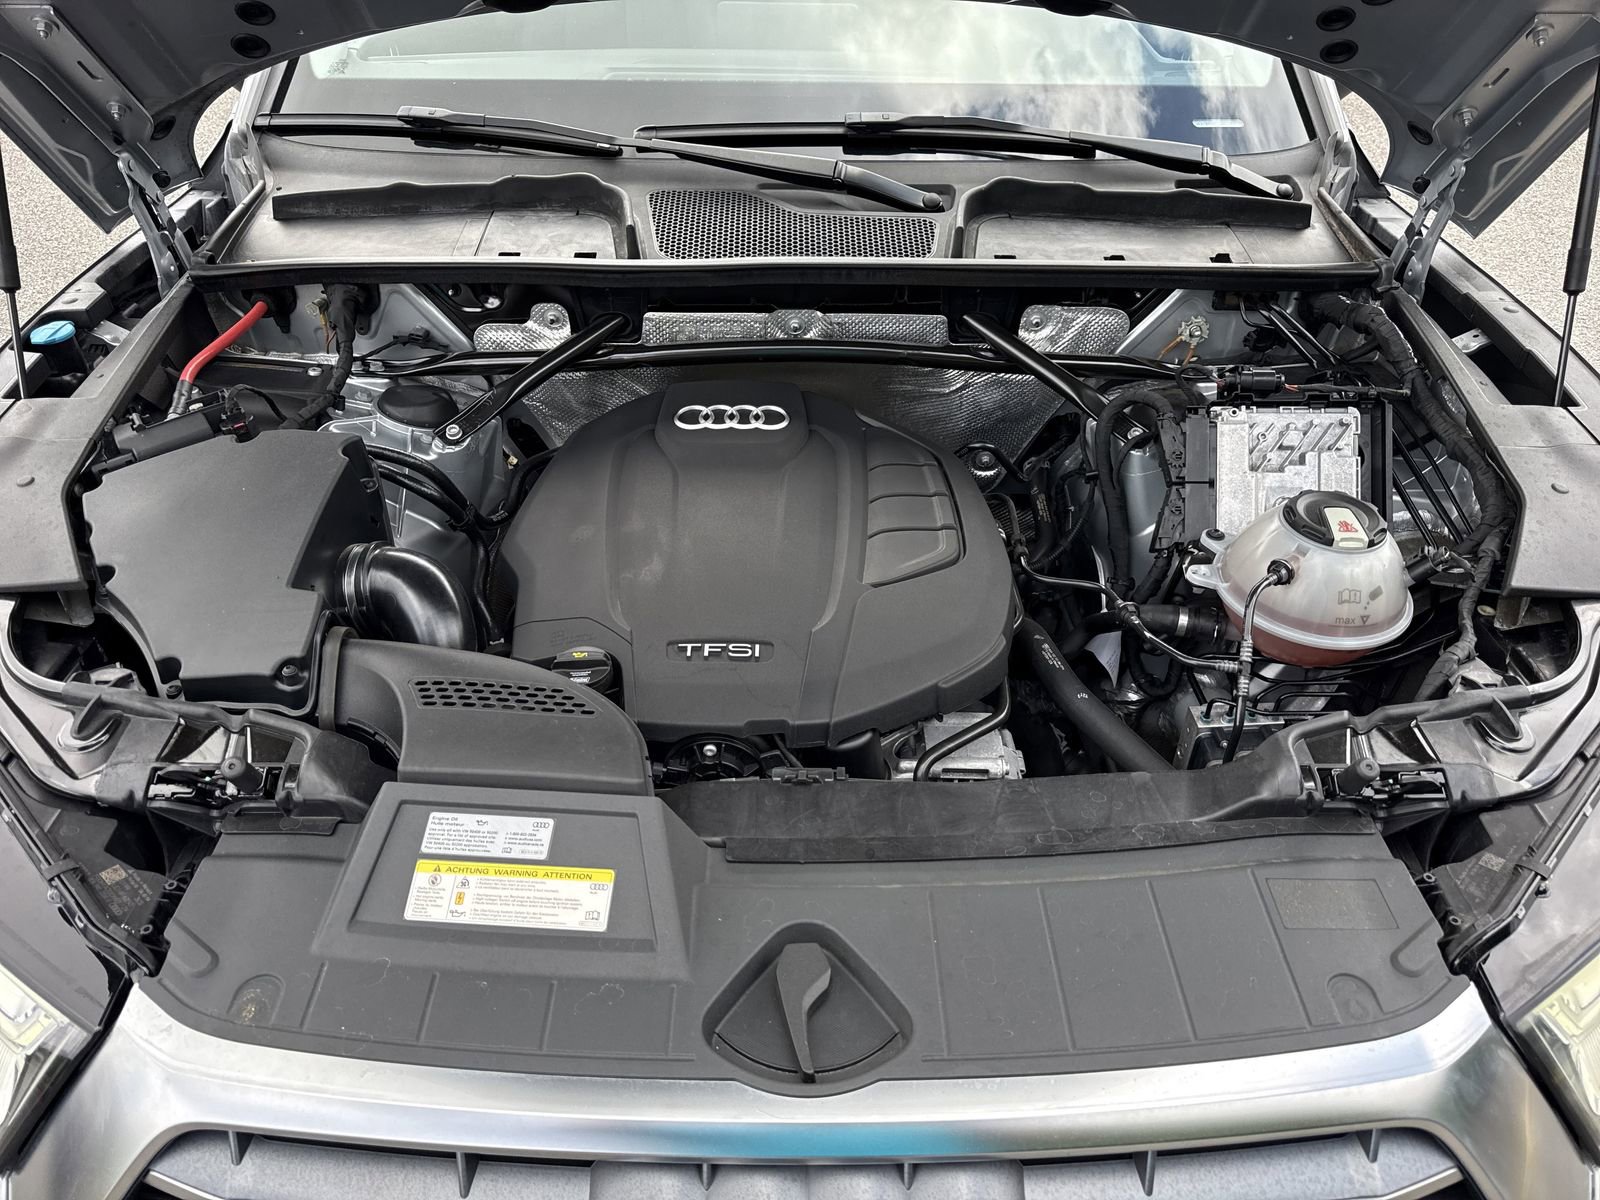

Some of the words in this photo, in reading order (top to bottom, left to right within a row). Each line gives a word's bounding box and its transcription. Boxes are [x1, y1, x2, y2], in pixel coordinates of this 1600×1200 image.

[678, 643, 760, 657] TFSI
[445, 866, 489, 875] ACHTUNG
[493, 868, 538, 878] WARNING
[543, 871, 593, 880] ATTENTION
